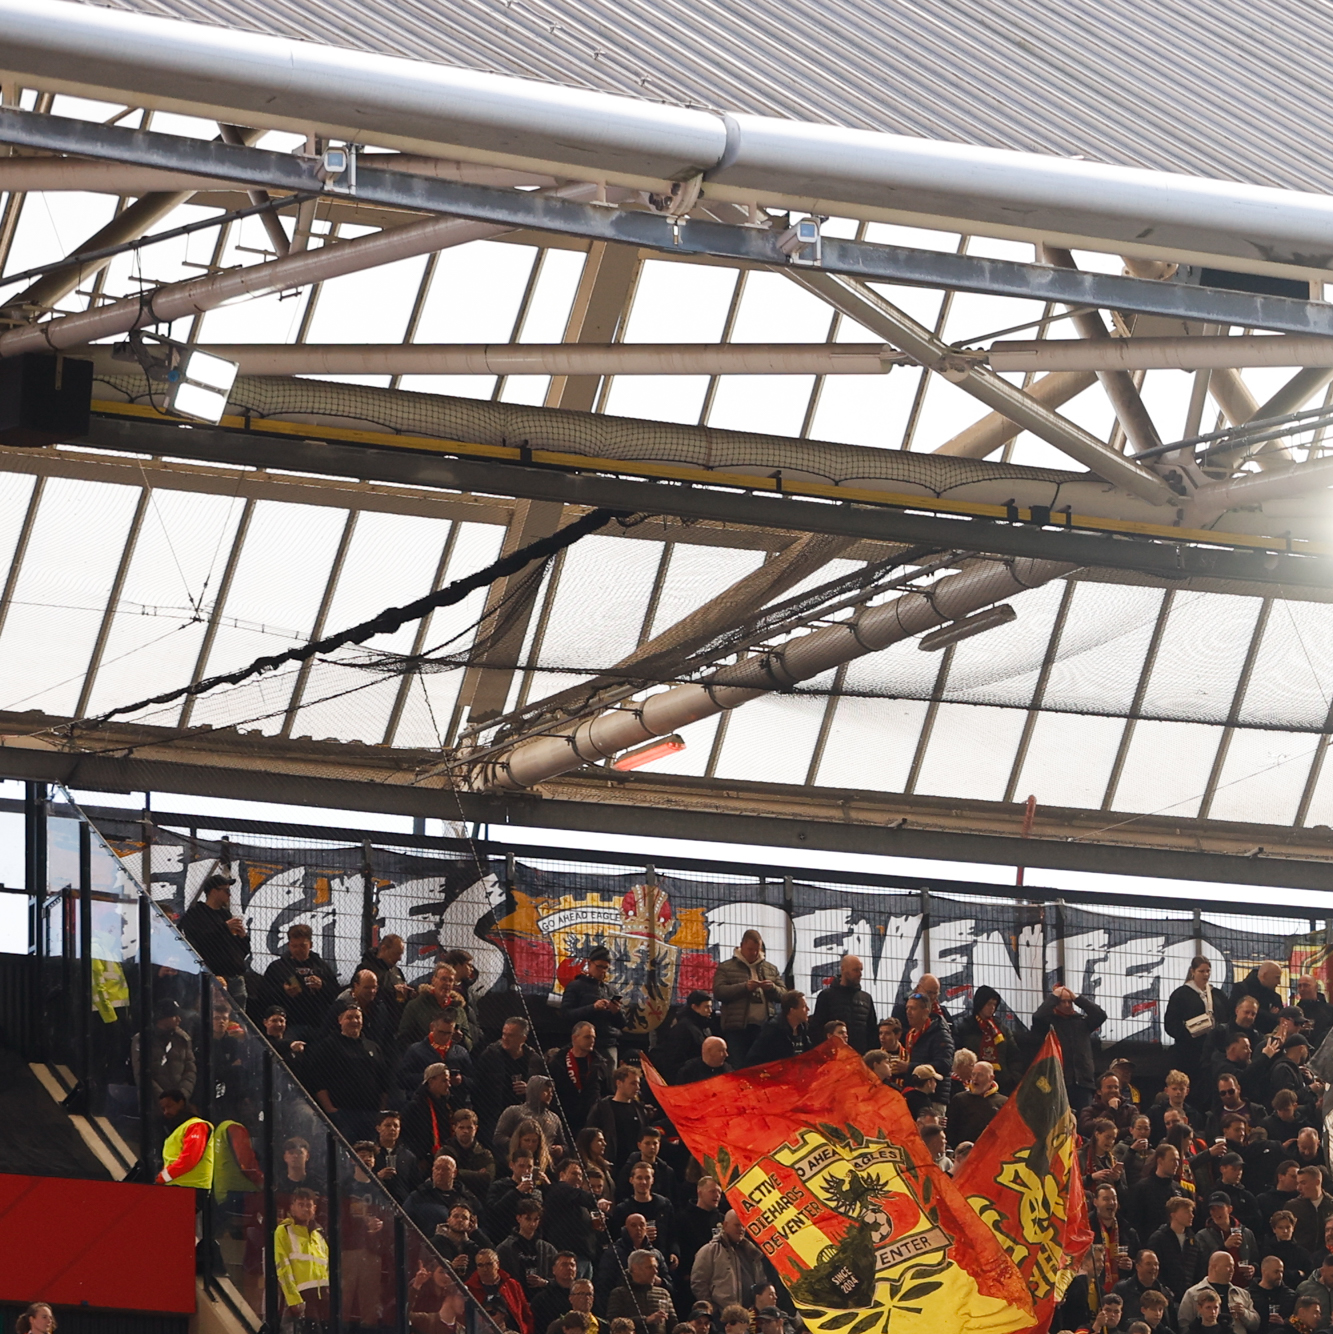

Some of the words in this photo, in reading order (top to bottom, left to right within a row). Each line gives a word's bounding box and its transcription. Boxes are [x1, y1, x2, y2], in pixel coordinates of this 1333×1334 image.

[541, 918, 556, 931] GO
[558, 911, 587, 924] AHEAD
[590, 911, 622, 922] EAGLE
[808, 1148, 841, 1172] AHEA
[854, 1150, 898, 1170] AGLES
[742, 1173, 783, 1213] ACTIVE
[748, 1186, 805, 1237] DIEHARDS
[761, 1200, 824, 1256] DEVENTER
[880, 1236, 932, 1266] ENTER
[831, 1266, 853, 1287] SINCE
[840, 1276, 860, 1294] 2004
